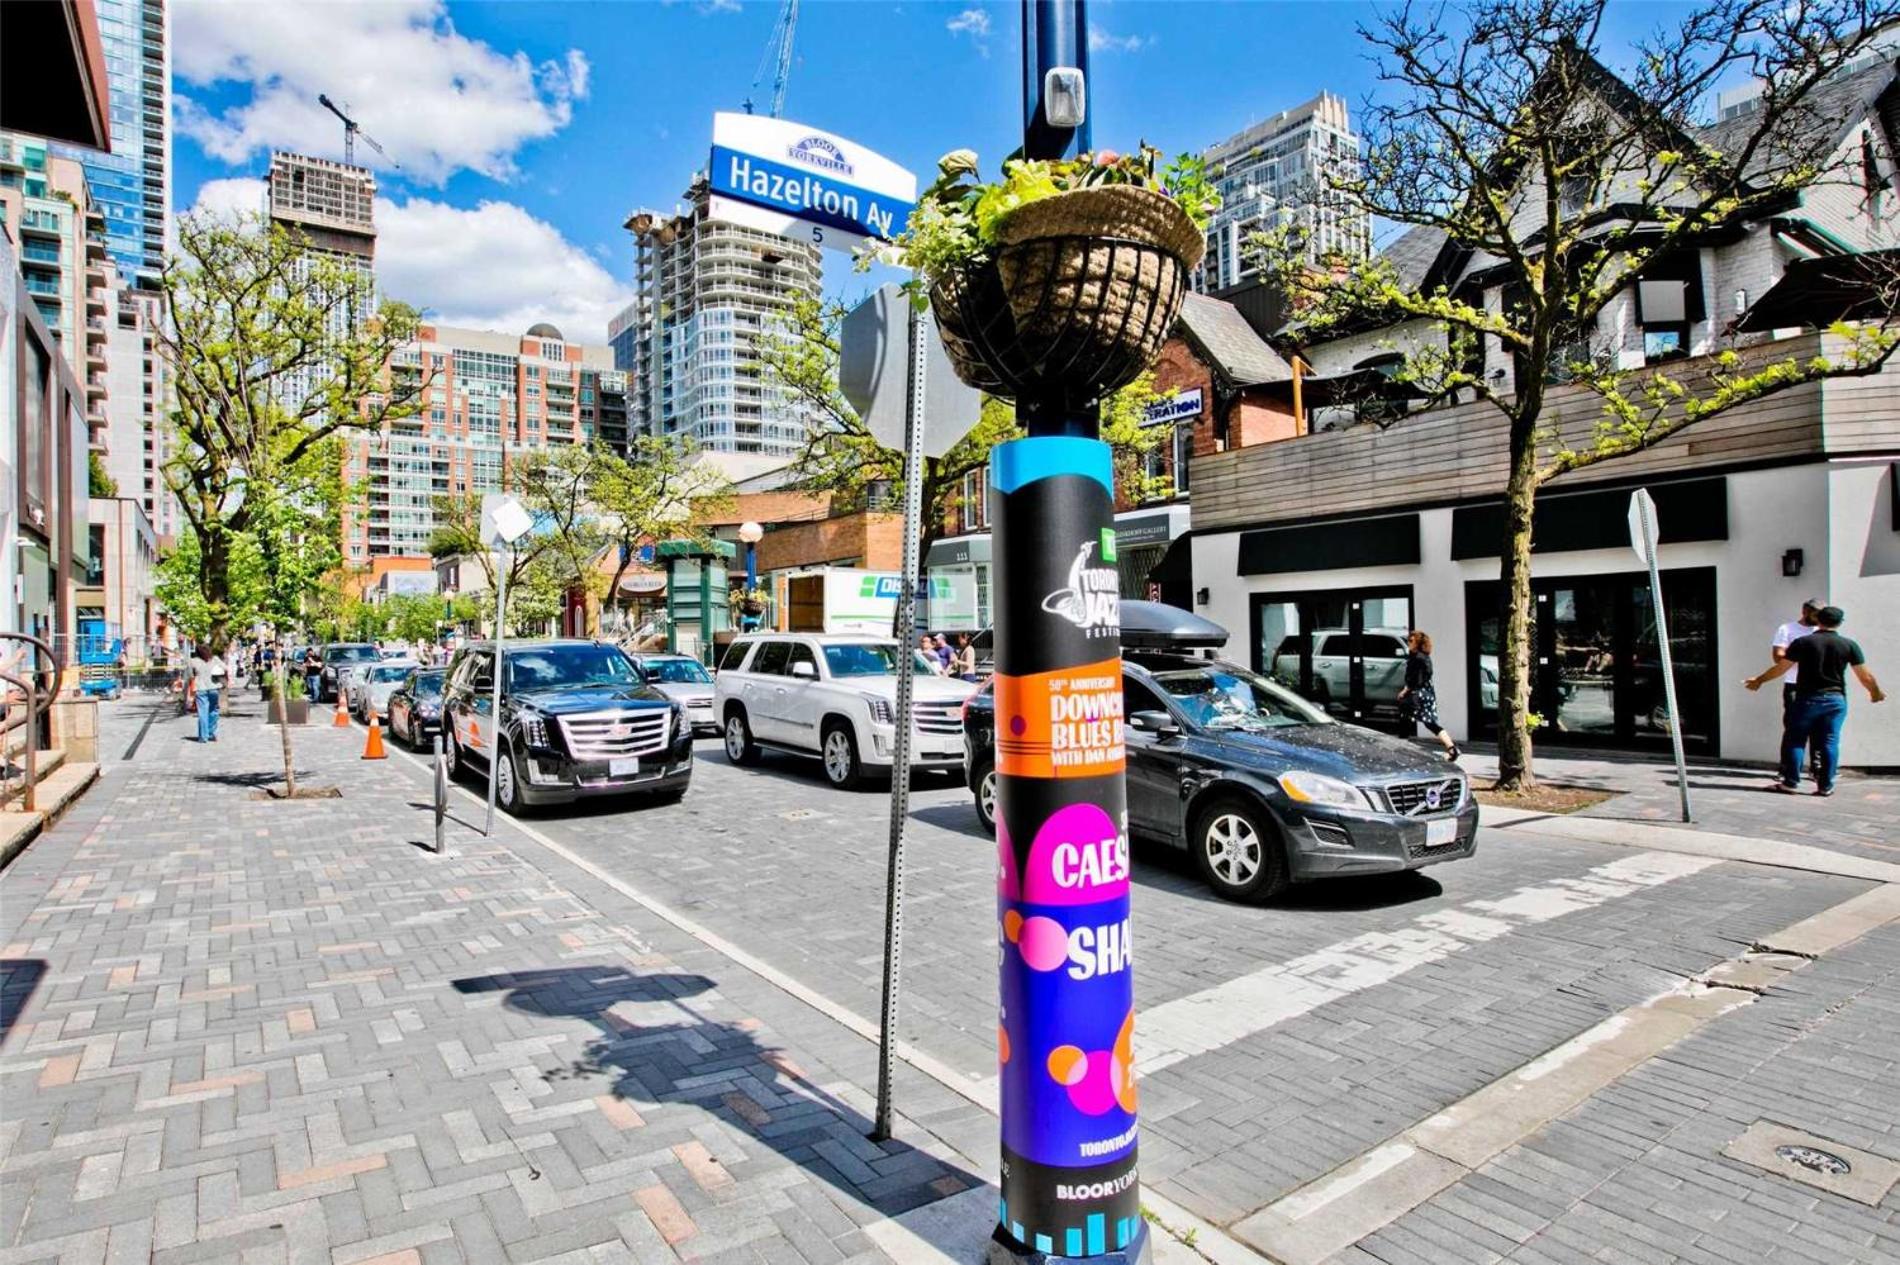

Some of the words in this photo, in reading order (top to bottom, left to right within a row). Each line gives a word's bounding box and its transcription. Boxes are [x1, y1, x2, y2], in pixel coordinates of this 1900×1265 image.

[730, 155, 859, 221] Hazelton
[866, 201, 893, 234] Av
[812, 227, 823, 243] 5
[956, 551, 968, 561] 111
[1052, 720, 1111, 749] BLUES
[1052, 750, 1083, 766] WITH
[1051, 834, 1129, 889] CAES
